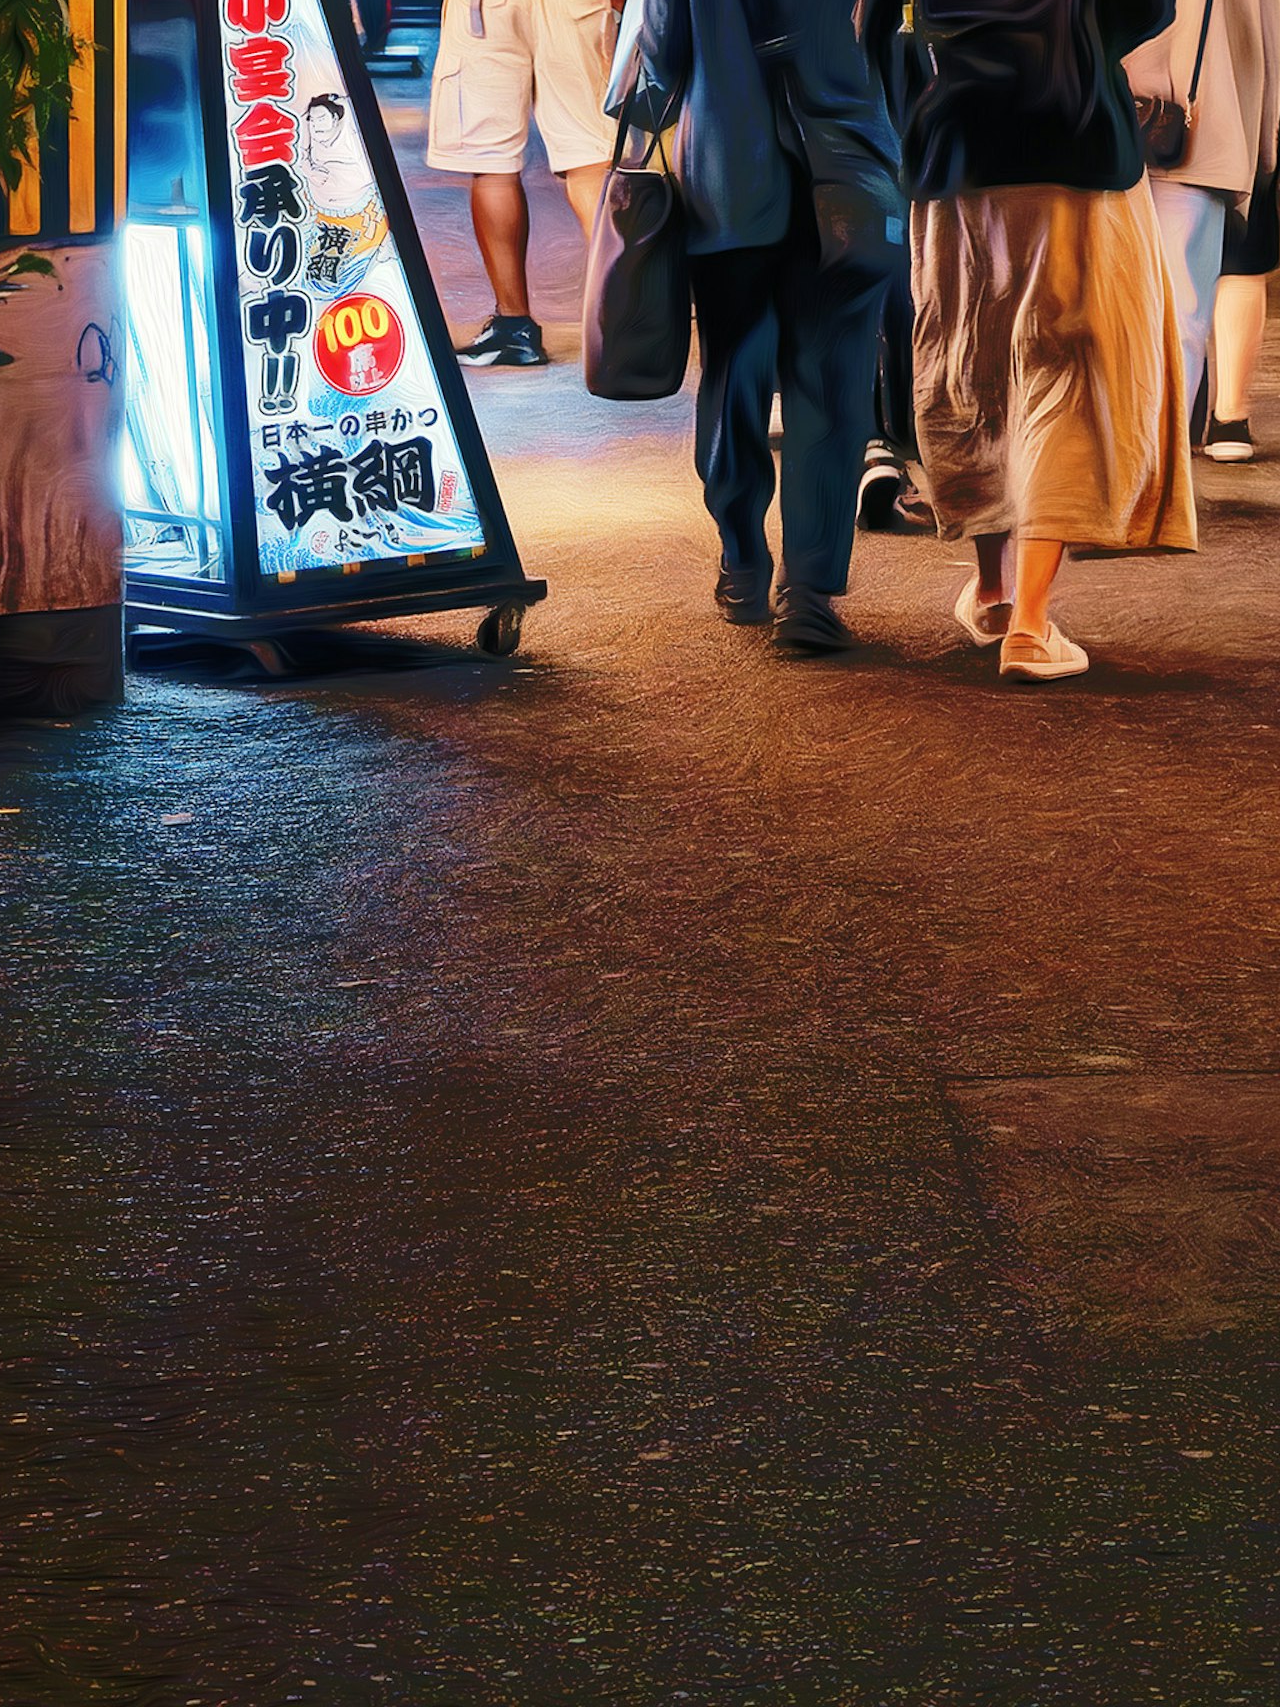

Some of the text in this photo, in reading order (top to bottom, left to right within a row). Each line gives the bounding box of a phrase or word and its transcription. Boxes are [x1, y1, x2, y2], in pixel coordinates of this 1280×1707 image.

[316, 299, 390, 353] 100
[260, 407, 439, 449] 日本一の串かつ
[263, 435, 436, 531] 横綱
